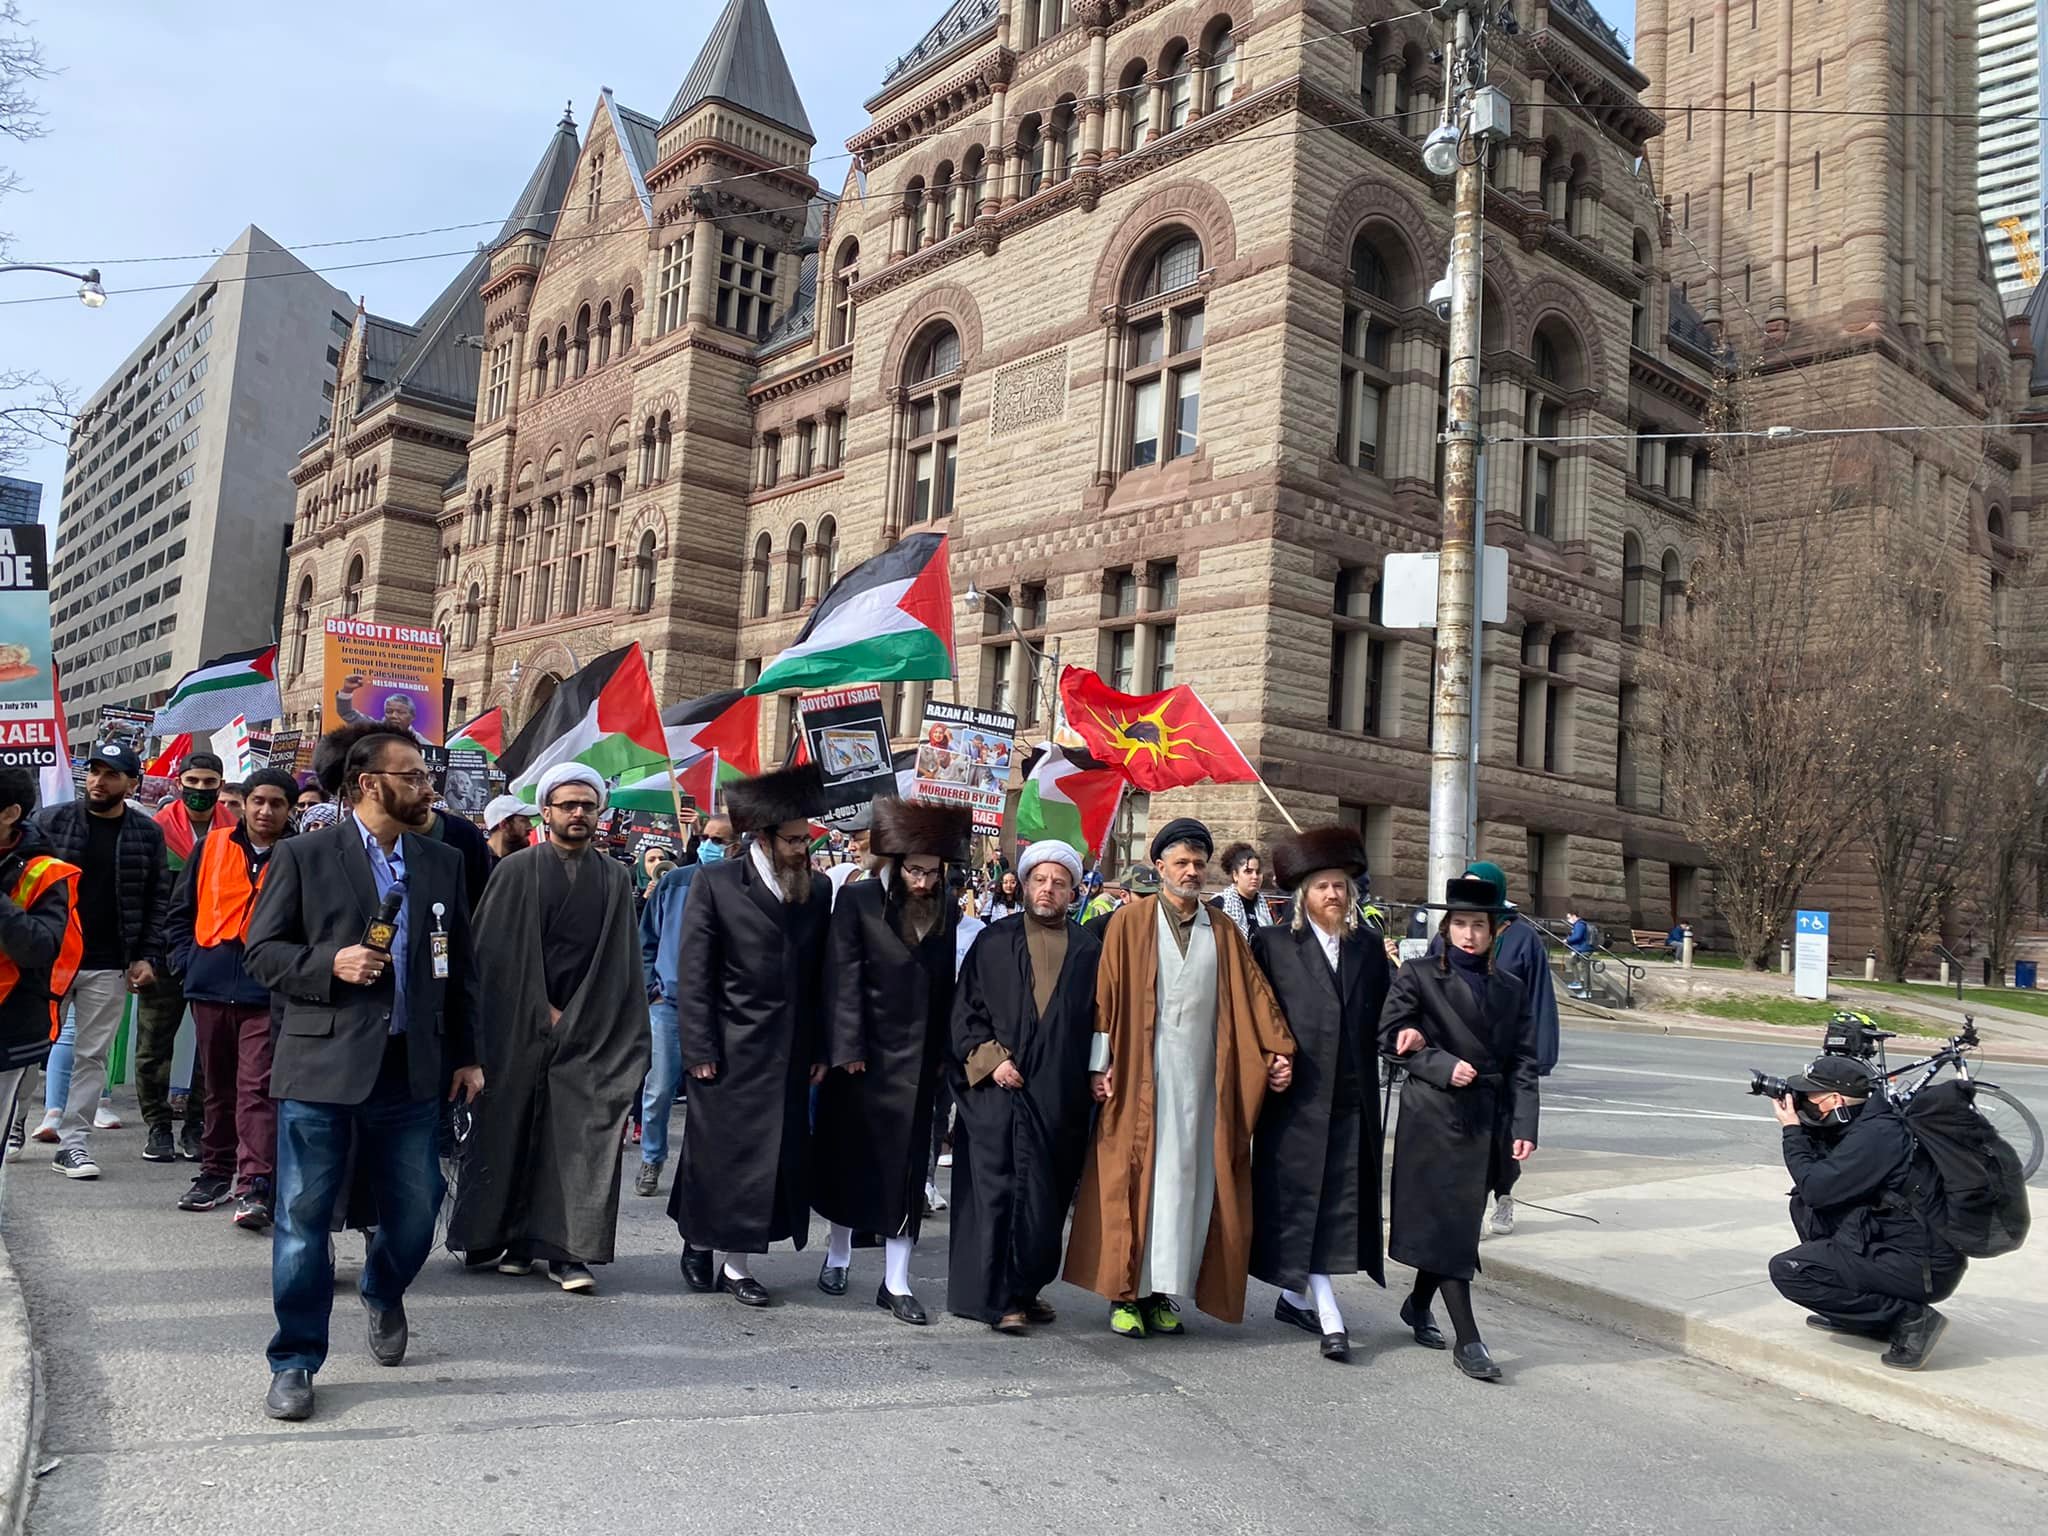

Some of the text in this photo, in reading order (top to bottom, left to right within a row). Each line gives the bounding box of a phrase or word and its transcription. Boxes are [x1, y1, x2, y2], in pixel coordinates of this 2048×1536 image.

[326, 619, 443, 646] BOYCOTT ISRAEL
[337, 635, 441, 655] We know too well that our
[341, 646, 435, 664] freedom is incomplete
[341, 657, 434, 673] without the freedom of
[353, 667, 420, 682] the Palestinians
[372, 679, 430, 692] NELSON MANDELA
[5, 702, 19, 711] July
[20, 702, 38, 710] 2014
[800, 687, 880, 712] BOYCOTT ISRAEL
[926, 704, 1016, 730] RAZAN AL-NAJJAR
[0, 723, 51, 745] RAEL
[919, 783, 970, 801] MURDERED
[971, 793, 984, 802] BY
[986, 796, 1001, 806] IDF
[972, 810, 998, 826] RAEL
[642, 833, 671, 842] UNITED
[972, 825, 999, 836] ONTO
